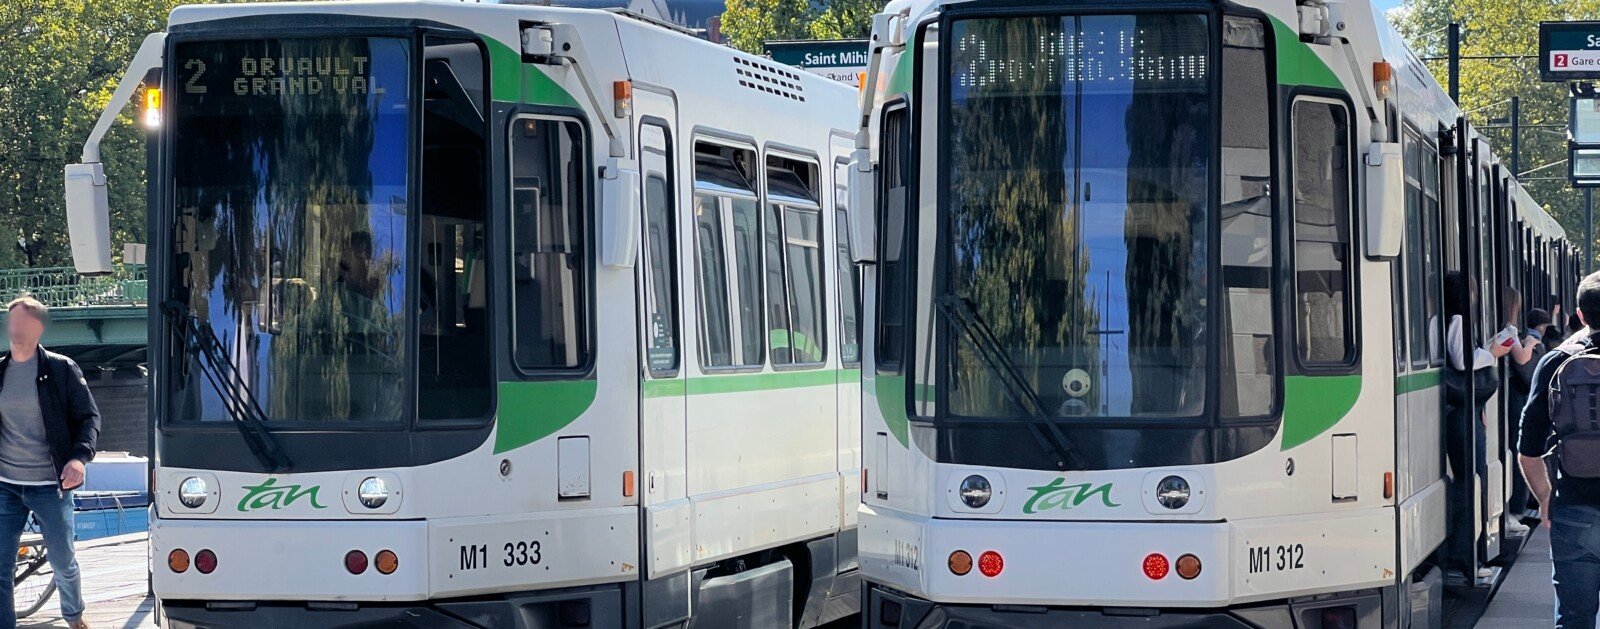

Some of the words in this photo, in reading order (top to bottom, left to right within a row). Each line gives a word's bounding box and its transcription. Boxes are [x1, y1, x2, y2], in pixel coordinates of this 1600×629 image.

[241, 56, 368, 76] ORVAULT
[804, 53, 837, 65] Saint
[1557, 55, 1565, 67] 2
[1571, 56, 1594, 66] Gare
[184, 58, 207, 93] 2
[233, 76, 322, 95] GRAND
[332, 75, 385, 94] VAL
[237, 478, 328, 512] tan
[1023, 477, 1122, 514] tan
[460, 544, 488, 570] M1
[503, 540, 542, 567] 333
[1249, 546, 1270, 573] M1
[1276, 543, 1304, 571] 312
